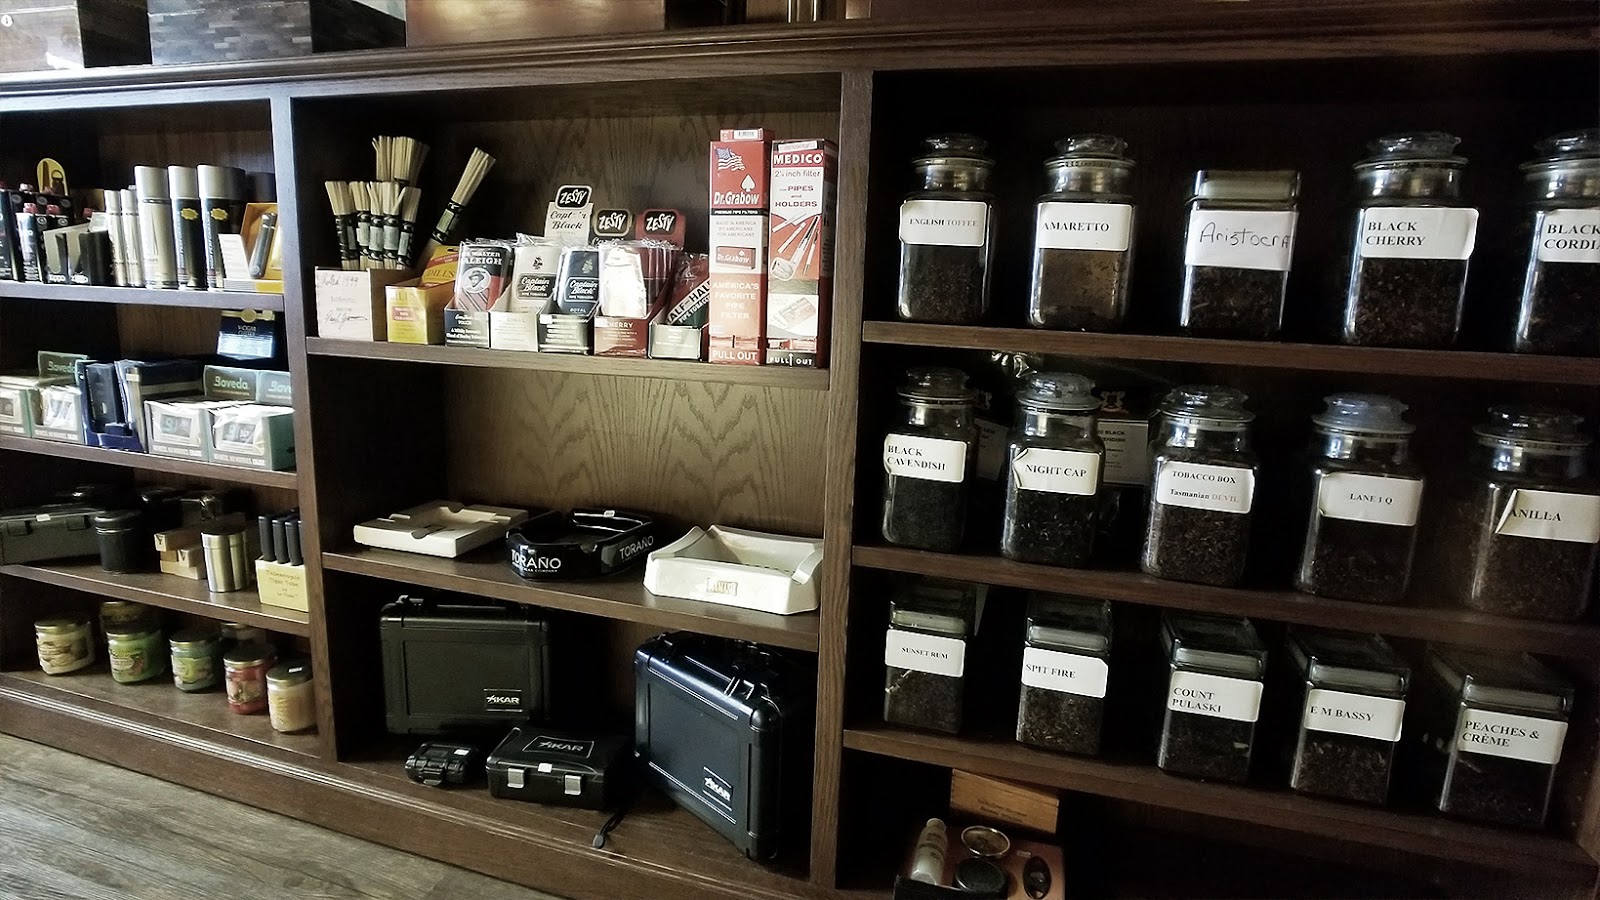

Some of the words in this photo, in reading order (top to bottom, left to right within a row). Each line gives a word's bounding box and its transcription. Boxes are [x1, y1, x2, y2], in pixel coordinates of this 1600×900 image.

[773, 154, 823, 165] MEDICO
[803, 170, 820, 178] filter
[559, 189, 588, 205] ZESTY
[552, 221, 583, 230] Black
[598, 212, 627, 231] ZESTY
[645, 213, 675, 232] ZESTY
[909, 218, 946, 227] ENGLISH
[1041, 221, 1110, 232] AMARETTO
[1367, 222, 1418, 232] BLACK
[1547, 224, 1600, 234] BLACK
[1365, 236, 1427, 246] CHERRY
[461, 257, 503, 265] ALEIGH
[521, 276, 550, 285] Captain
[569, 279, 599, 288] Captain
[712, 282, 759, 290] AMERICA'S
[523, 284, 549, 292] Black
[571, 286, 596, 294] Black
[715, 292, 757, 300] FAVORITE
[606, 321, 633, 329] HERRY
[712, 350, 736, 360] PULL
[737, 350, 758, 360] OUT
[795, 358, 813, 366] OUT
[214, 375, 250, 391] Boveda
[887, 445, 924, 457] BLACK
[886, 457, 946, 471] CAVENDISH
[1025, 463, 1062, 476] NIGHT
[1063, 467, 1088, 478] CAP
[1171, 470, 1216, 482] TOBACCO
[1217, 475, 1237, 484] BOX
[1169, 487, 1211, 500] Tasmanian
[1350, 493, 1377, 503] LANE
[1385, 497, 1393, 505] Q
[1512, 508, 1562, 521] ANILLA
[619, 535, 655, 560] TORAÑO
[510, 548, 562, 569] TORAÑO
[900, 646, 931, 657] SUNSET
[931, 652, 949, 660] RUM
[1025, 663, 1049, 674] SPIT
[1050, 668, 1077, 679] FIRE
[486, 694, 520, 704] XIKAR
[1172, 687, 1215, 701] COUNT
[1171, 699, 1223, 713] PULASKI
[1465, 720, 1527, 738] PEACHES
[1529, 730, 1540, 742] &
[538, 740, 584, 753] XIKAR
